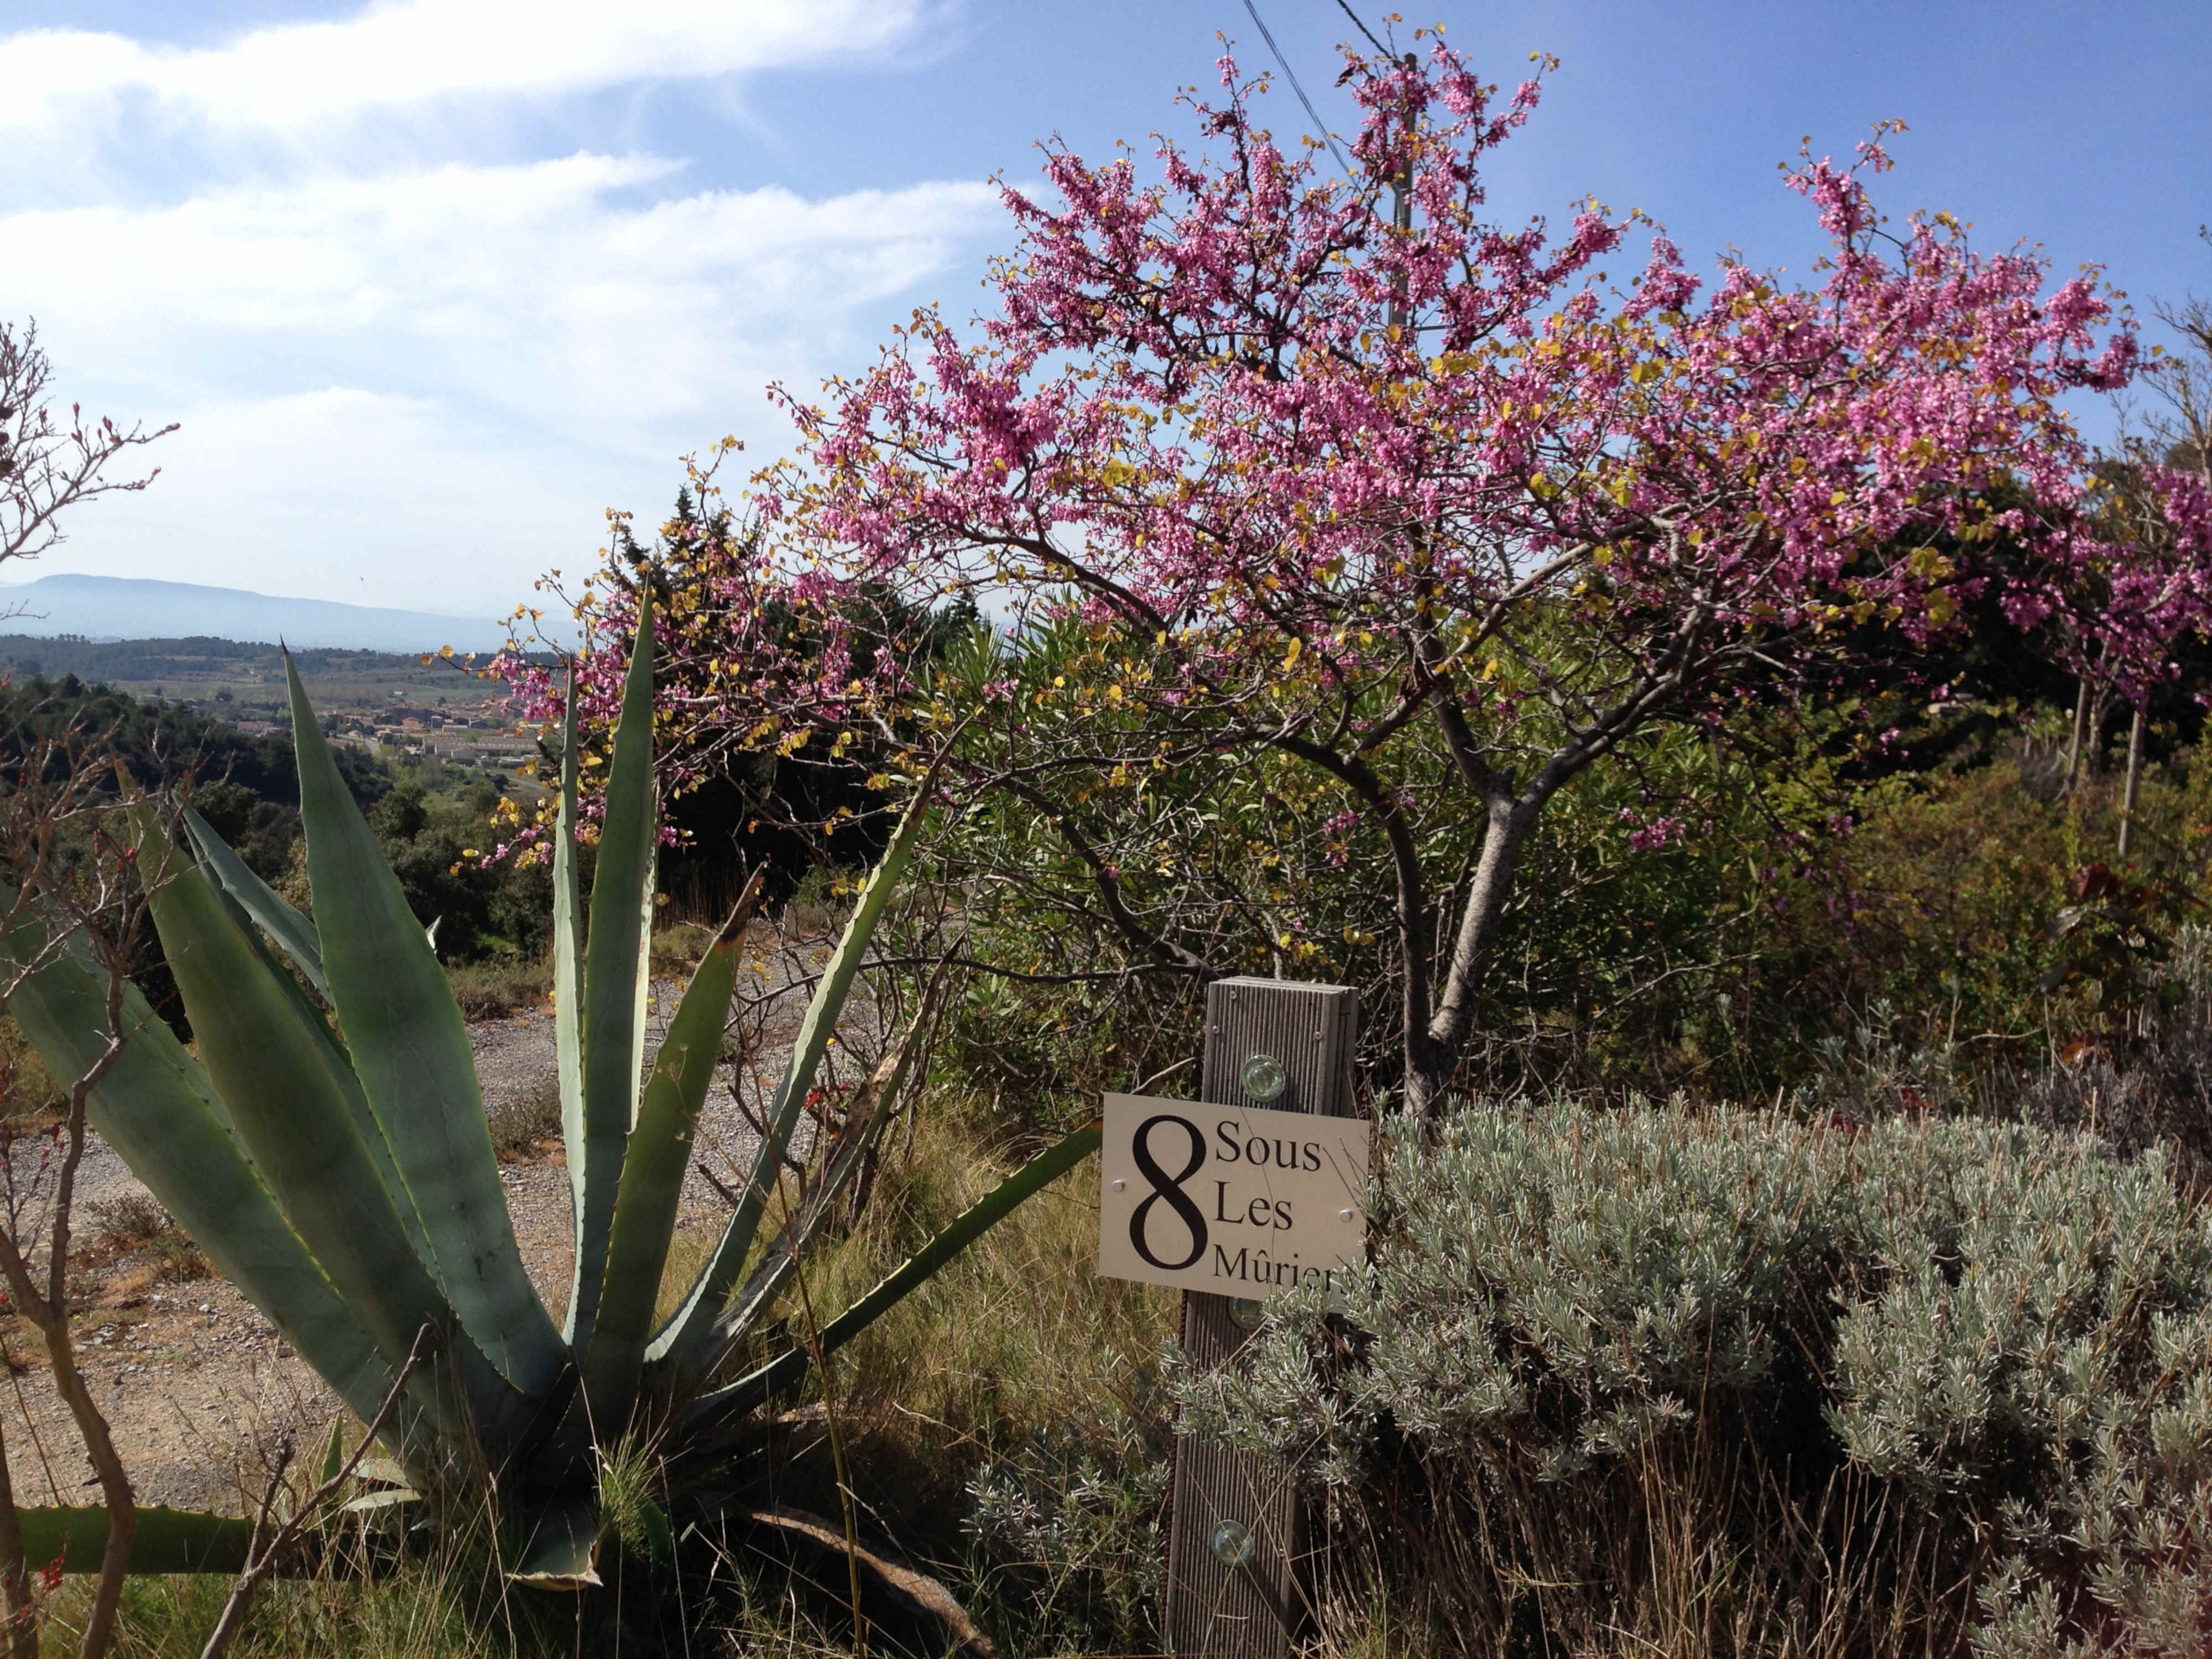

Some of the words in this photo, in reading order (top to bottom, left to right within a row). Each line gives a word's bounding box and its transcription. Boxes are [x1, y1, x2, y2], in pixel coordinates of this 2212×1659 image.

[1216, 1120, 1321, 1172] Sous
[1129, 1114, 1208, 1270] 8
[1213, 1180, 1292, 1230] Les
[1212, 1244, 1348, 1295] Mûrier
